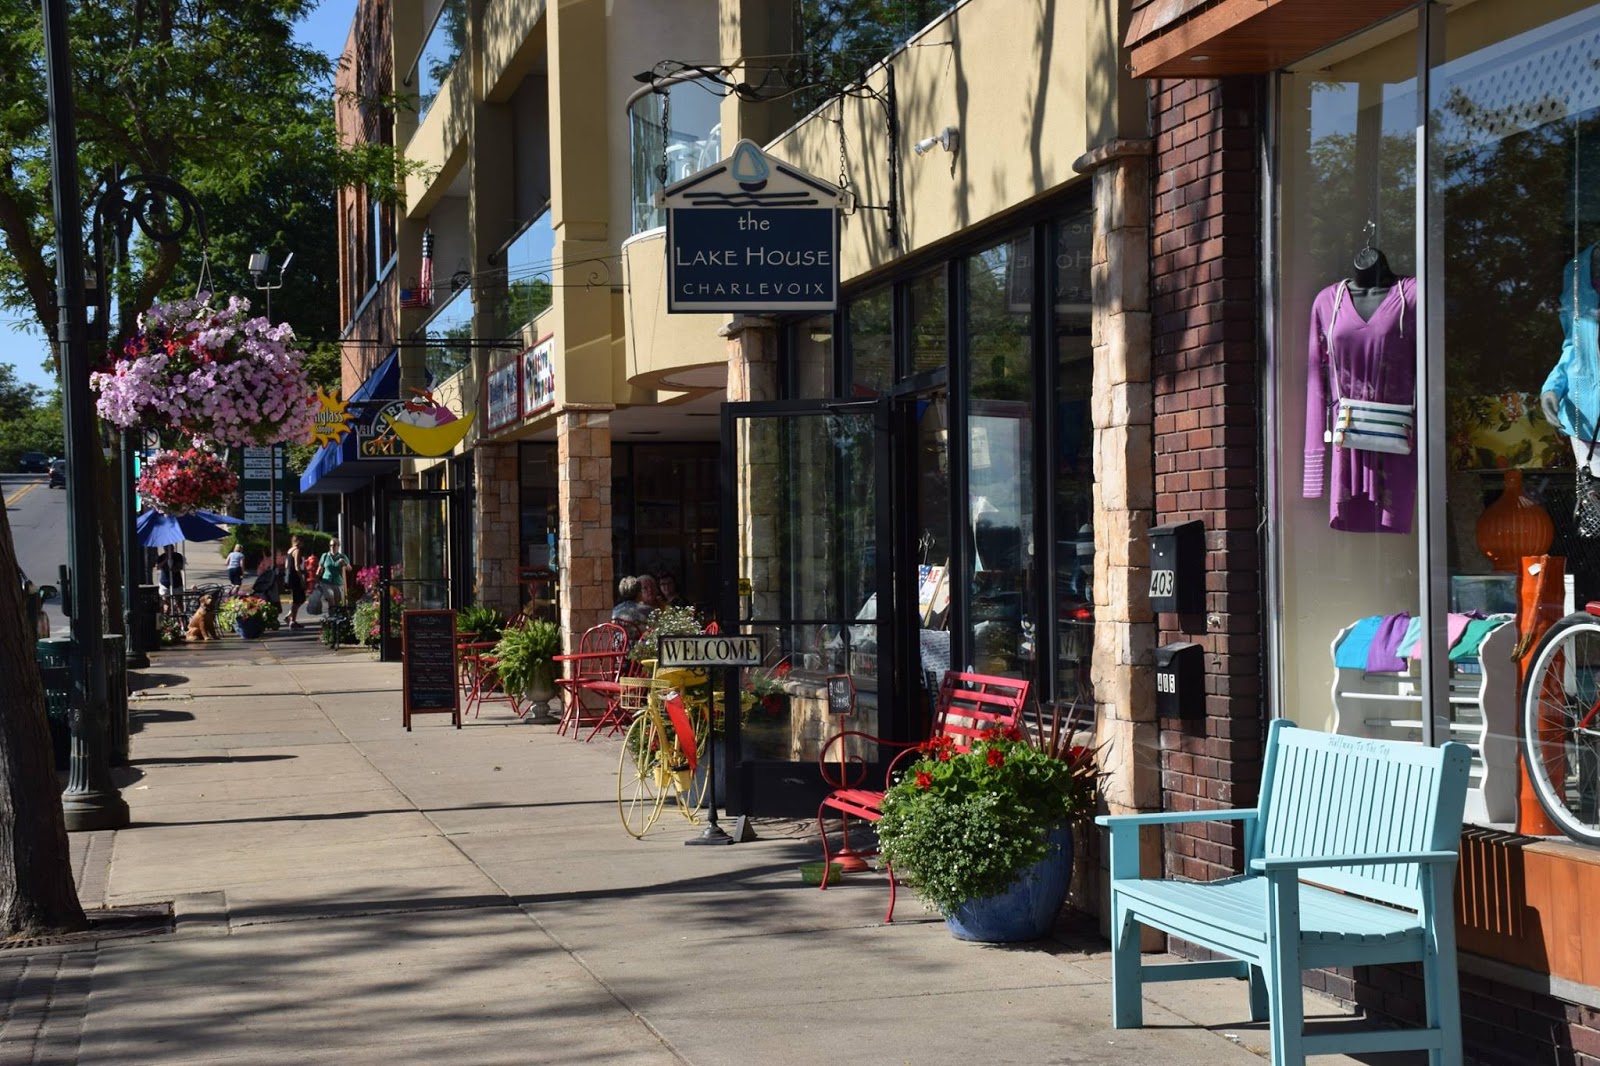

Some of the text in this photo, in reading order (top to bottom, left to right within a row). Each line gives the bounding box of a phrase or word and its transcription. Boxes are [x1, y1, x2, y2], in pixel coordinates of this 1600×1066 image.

[738, 211, 770, 231] the
[676, 246, 830, 266] LAKE HOUSE
[683, 283, 824, 295] CHARLEVOIX
[1150, 571, 1173, 595] 403
[664, 639, 757, 661] WELCOME
